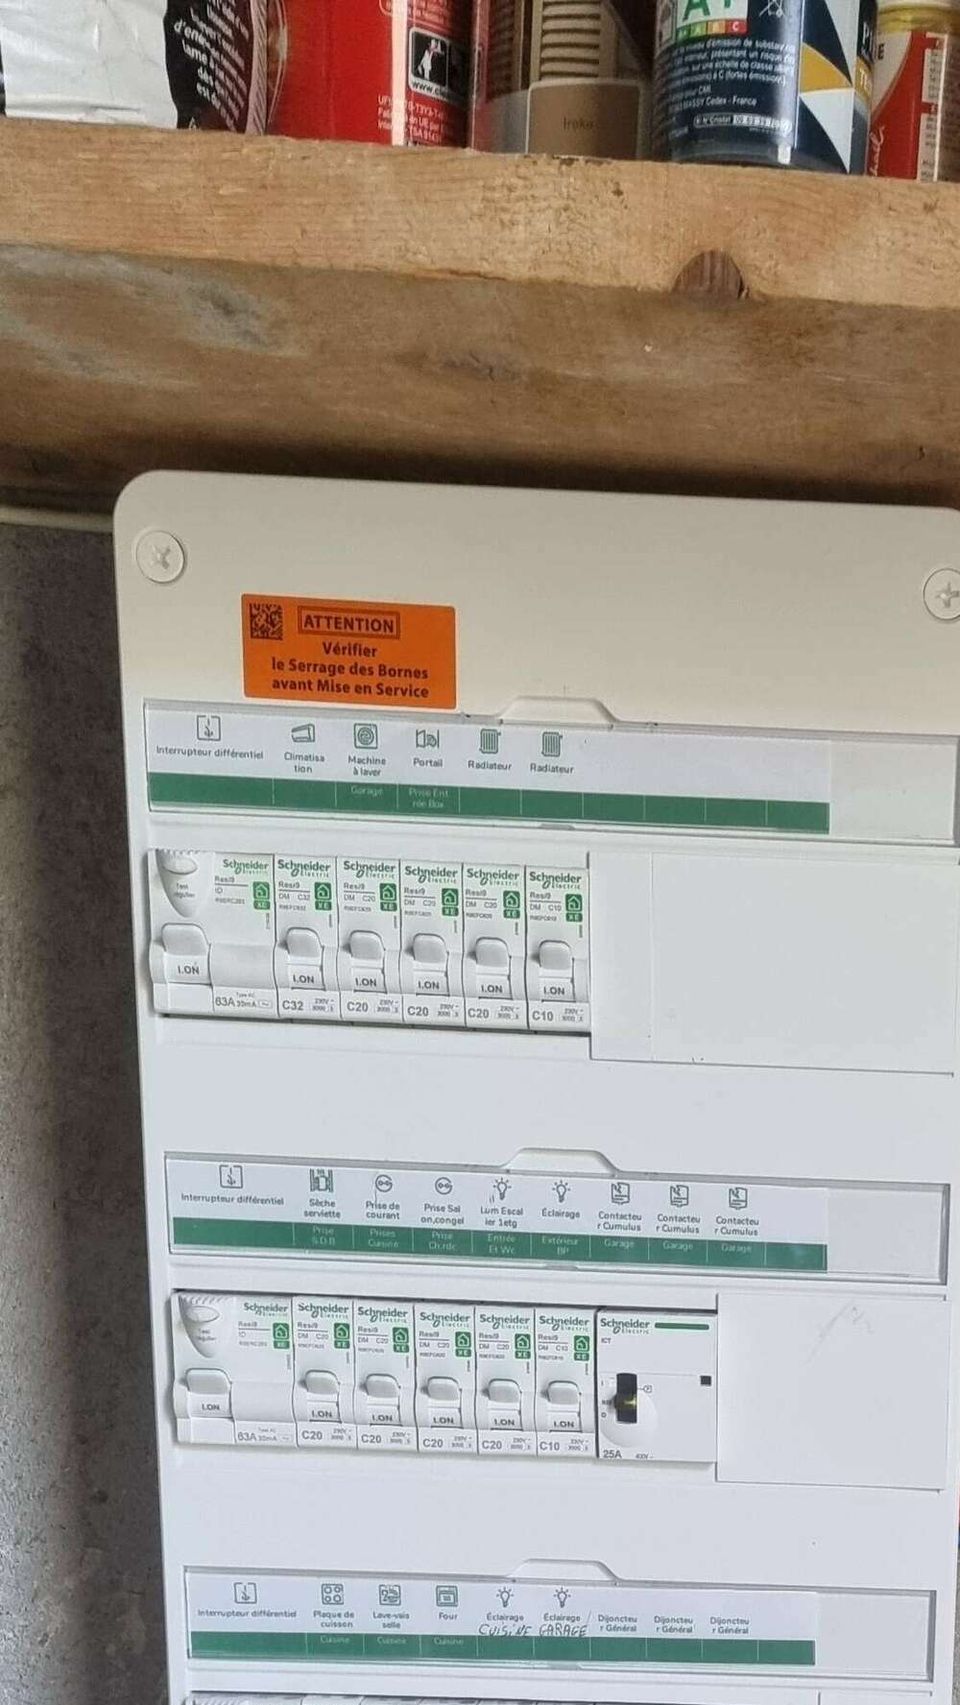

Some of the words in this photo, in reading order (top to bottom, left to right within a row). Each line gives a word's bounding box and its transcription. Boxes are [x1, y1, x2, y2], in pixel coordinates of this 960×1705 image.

[303, 614, 395, 634] ATTENTION
[322, 641, 378, 659] Vérifier
[271, 657, 285, 671] le
[288, 659, 345, 678] Serrage
[349, 661, 374, 677] des
[378, 663, 429, 680] Bornes
[272, 678, 313, 692] avant
[316, 679, 350, 694] Mise
[354, 683, 373, 695] en
[376, 681, 430, 698] Service
[156, 745, 212, 758] Interrupteur
[214, 748, 264, 760] différentiel
[284, 752, 326, 763] Climatisa
[348, 755, 387, 766] Machine
[413, 757, 444, 768] Portail
[467, 760, 513, 771] Radiateur
[294, 764, 314, 774] tion
[360, 767, 382, 778] laver
[529, 763, 576, 775] Radiateur
[223, 858, 269, 875] Schneider
[277, 859, 331, 877] Schneider
[343, 860, 396, 879] Schneider
[404, 866, 458, 885] Schneider
[466, 868, 520, 887] Schneider
[529, 872, 582, 890] Schneider
[282, 999, 304, 1012] C32
[346, 1002, 369, 1013] C20
[407, 1006, 430, 1018] C20
[467, 1009, 490, 1020] C20
[532, 1011, 554, 1022] C10
[181, 1193, 235, 1205] Interrupteur
[236, 1194, 285, 1206] différentiel
[365, 1200, 386, 1211] Prise
[388, 1202, 401, 1211] de
[424, 1203, 446, 1214] Prise
[447, 1204, 461, 1214] Sal
[303, 1209, 341, 1220] serviette
[366, 1211, 400, 1221] courant
[480, 1206, 500, 1217] Lum
[500, 1206, 524, 1217] Escal
[541, 1207, 580, 1220] Éclairage
[598, 1211, 642, 1222] Contacteu
[657, 1213, 701, 1224] Contacteu
[715, 1216, 760, 1227] Contacteu
[602, 1221, 642, 1233] Cumulus
[661, 1223, 700, 1235] Cumulus
[720, 1226, 759, 1237] Cumulus
[243, 1302, 288, 1316] Schneider
[298, 1303, 349, 1319] Schneider
[358, 1306, 408, 1323] Schneider
[419, 1312, 470, 1328] Schneider
[479, 1314, 530, 1330] Schneider
[538, 1315, 590, 1332] Schneider
[600, 1318, 650, 1334] Schneider
[301, 1431, 323, 1440] C20
[361, 1434, 382, 1443] C20
[422, 1438, 444, 1448] C20
[482, 1440, 503, 1450] C20
[539, 1441, 560, 1451] C10
[602, 1449, 622, 1460] 25A
[198, 1609, 249, 1619] Interrupteur
[313, 1611, 342, 1622] Plaque
[343, 1612, 355, 1620] de
[438, 1612, 458, 1620] Four
[486, 1612, 524, 1623] Éclairage
[543, 1613, 581, 1624] Éclairage
[598, 1614, 638, 1625] Dijoncteu
[320, 1620, 353, 1629] cuisson
[654, 1615, 693, 1626] Dijoncteu
[710, 1616, 750, 1627] Dijoncteu
[606, 1623, 638, 1633] Général
[661, 1624, 694, 1634] Général
[717, 1625, 750, 1635] Général
